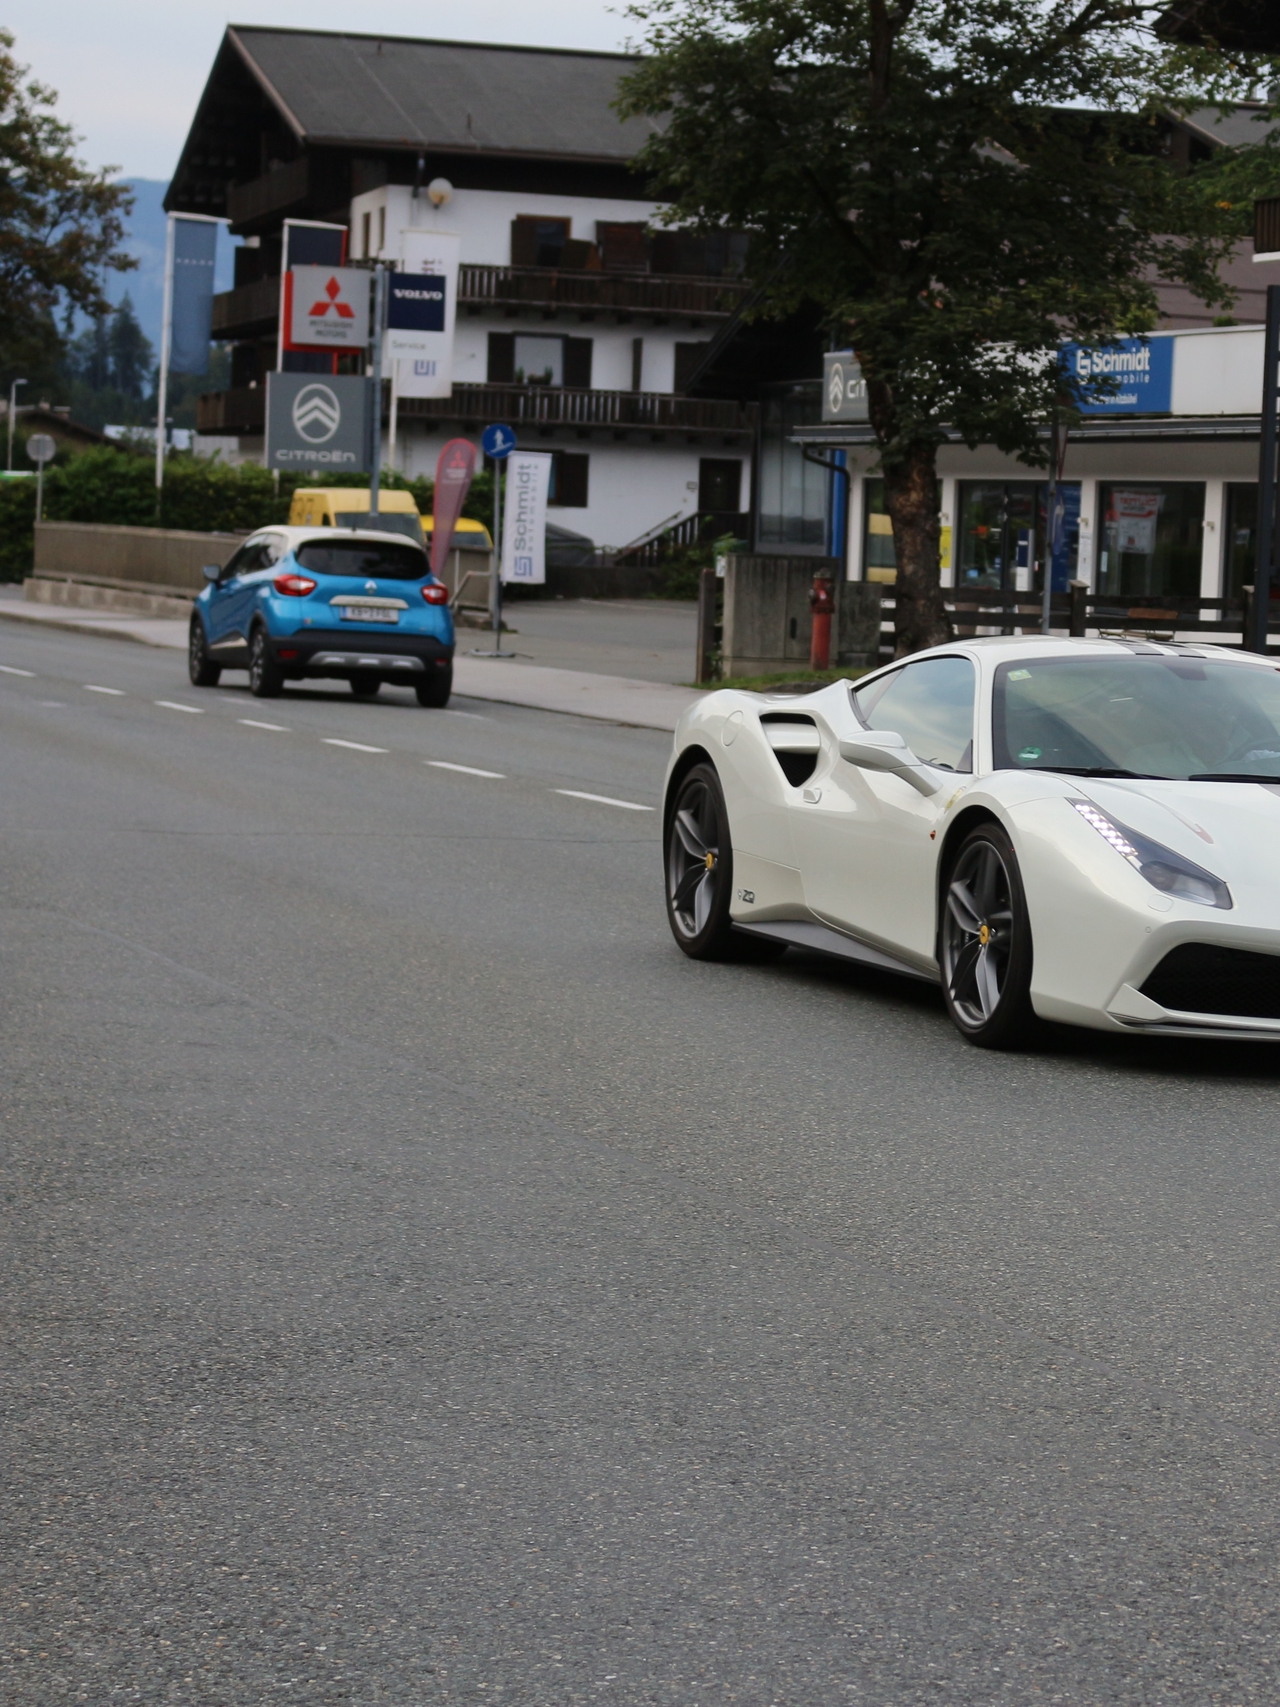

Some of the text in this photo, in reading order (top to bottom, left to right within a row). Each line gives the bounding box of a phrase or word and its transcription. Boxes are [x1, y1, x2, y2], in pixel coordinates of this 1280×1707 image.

[393, 288, 443, 300] VOLVO
[392, 340, 427, 350] Service
[1092, 347, 1151, 372] Schmidt
[513, 463, 532, 551] Schmidt
